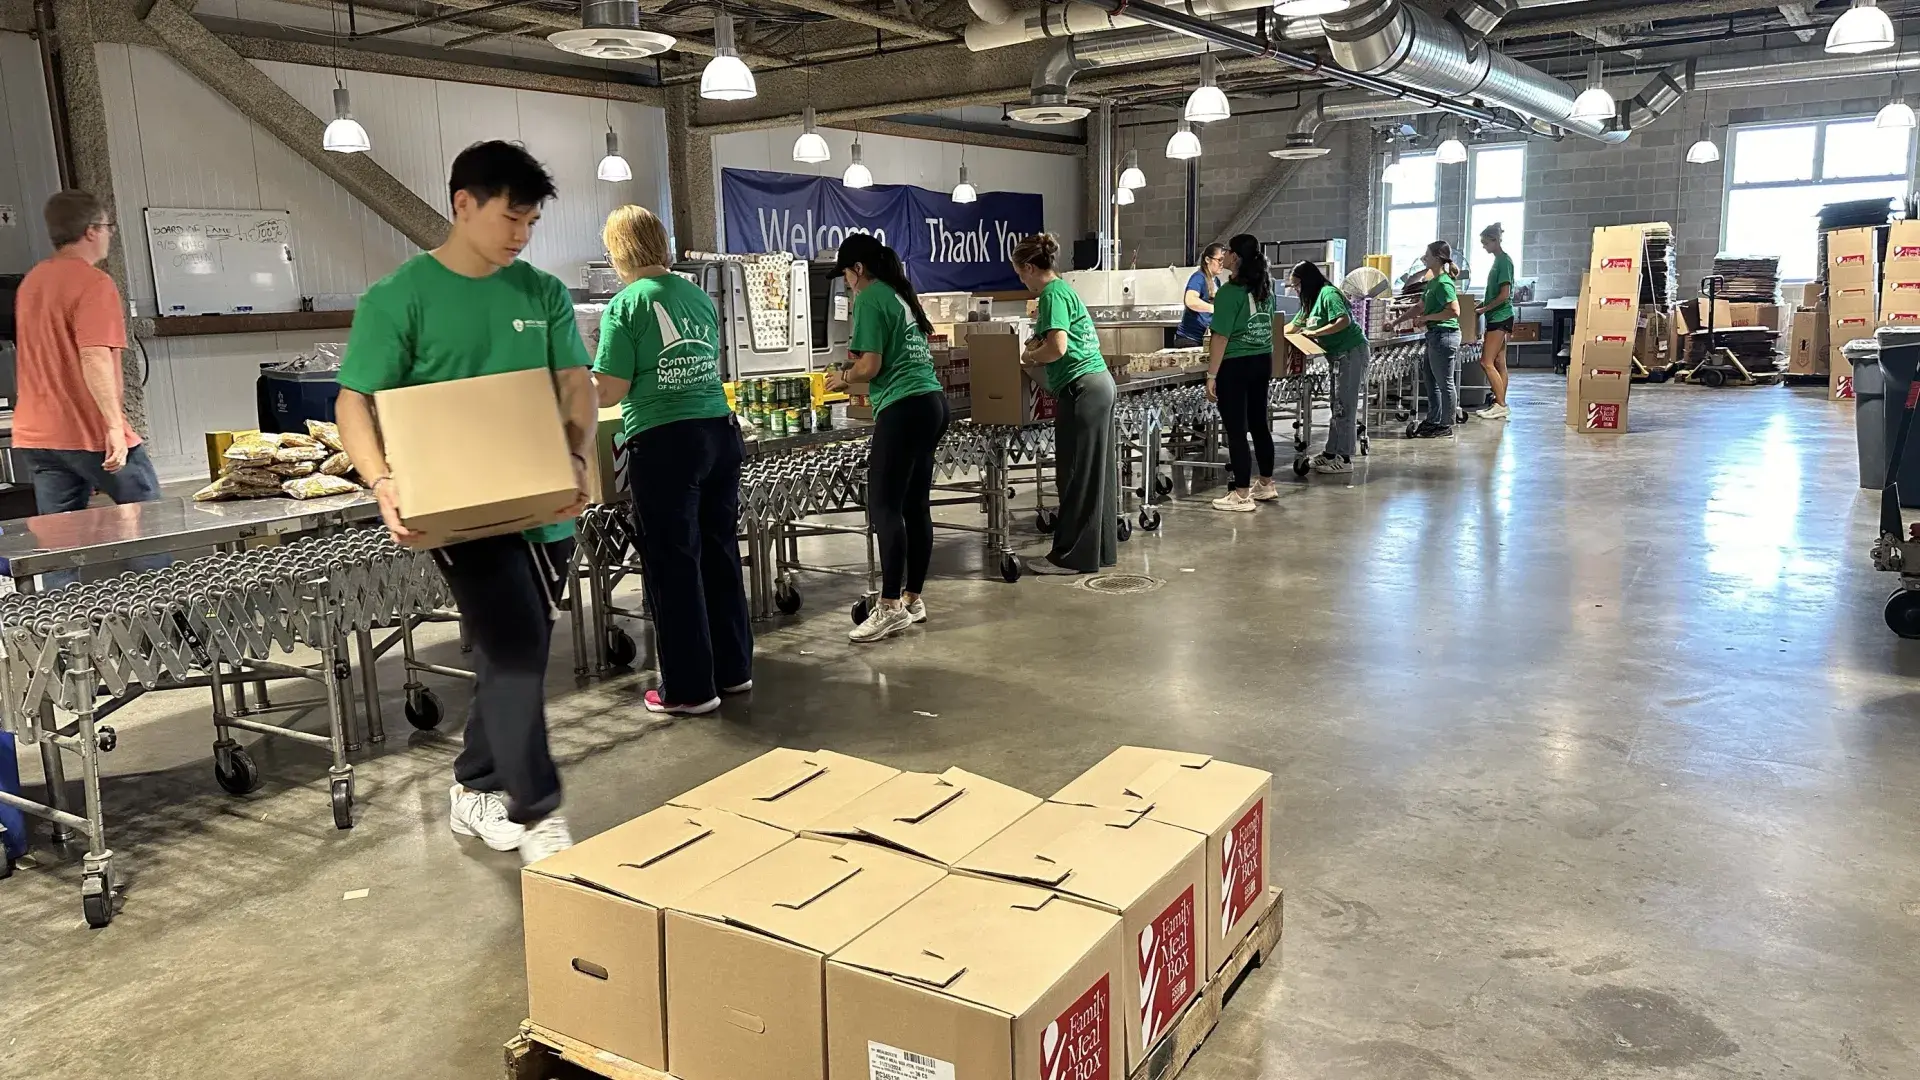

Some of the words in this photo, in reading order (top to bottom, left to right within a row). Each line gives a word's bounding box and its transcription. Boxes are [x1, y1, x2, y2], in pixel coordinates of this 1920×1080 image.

[925, 217, 990, 263] Thank
[657, 364, 701, 378] IMPACT
[1237, 828, 1258, 870] Meal
[1239, 808, 1260, 847] Family
[1161, 899, 1191, 942] Family
[1161, 920, 1187, 969] Meal
[1167, 947, 1189, 986] Box
[1069, 989, 1106, 1042] Family
[1067, 1015, 1101, 1072] Meal
